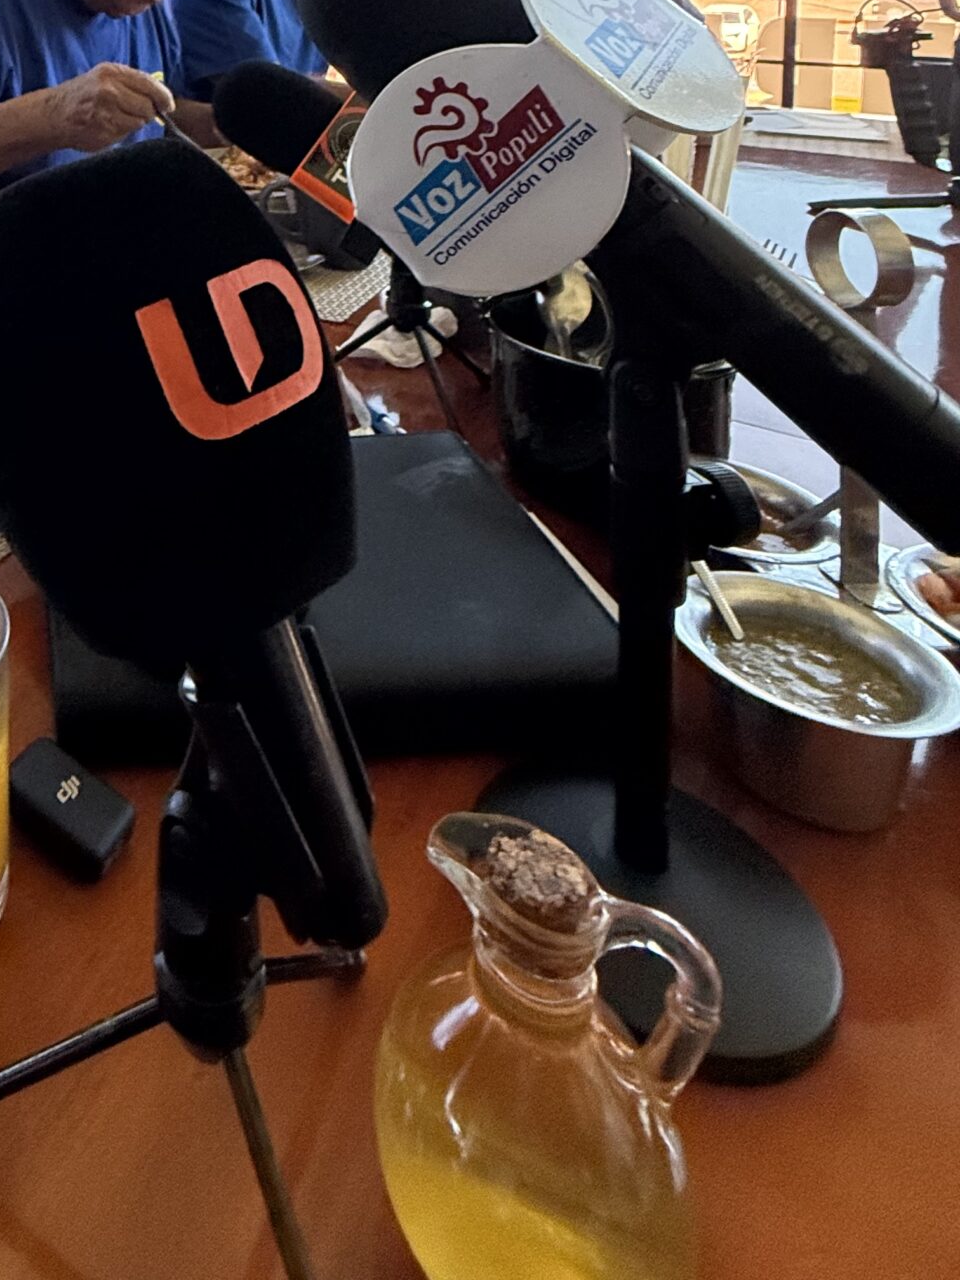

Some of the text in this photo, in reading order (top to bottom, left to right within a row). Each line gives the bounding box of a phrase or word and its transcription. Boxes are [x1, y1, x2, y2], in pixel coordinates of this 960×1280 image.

[432, 122, 599, 266] Comunicación Digital
[478, 103, 554, 180] Populi
